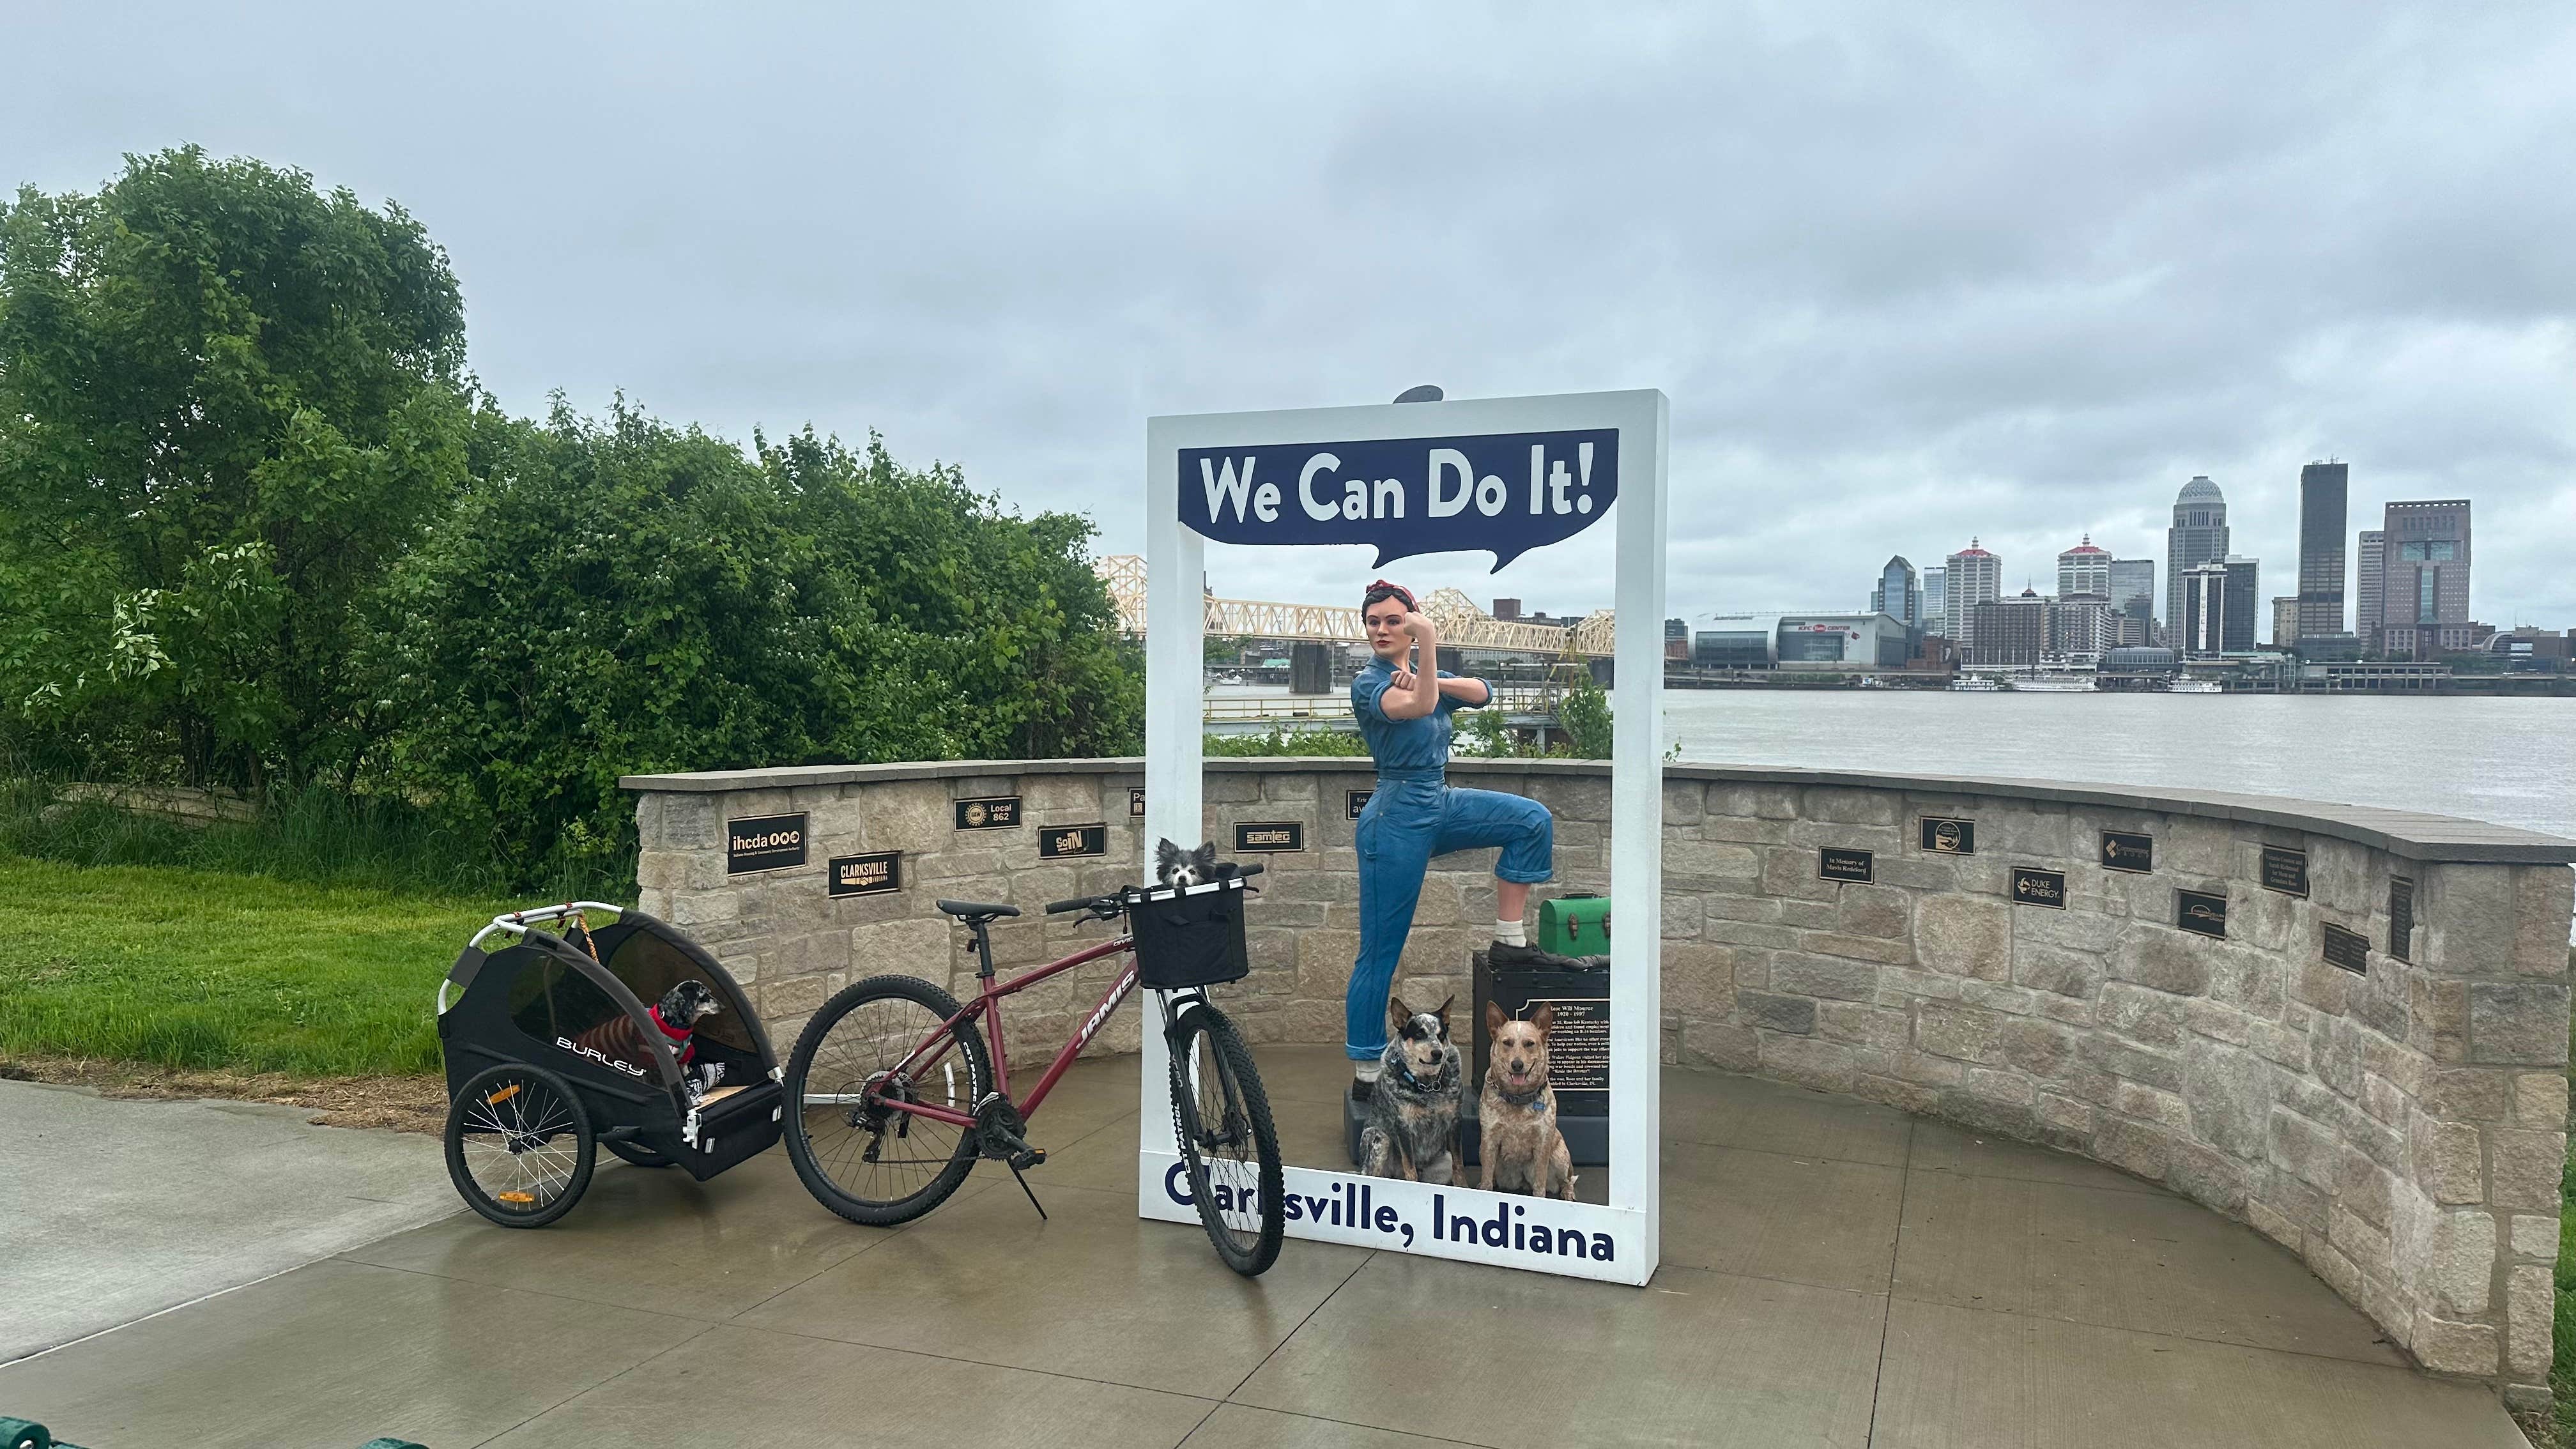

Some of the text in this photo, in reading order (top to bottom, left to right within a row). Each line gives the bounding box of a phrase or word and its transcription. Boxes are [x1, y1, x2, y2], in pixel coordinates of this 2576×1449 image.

[1200, 442, 1594, 524] We Can Do It!
[990, 804, 1012, 812] Local
[993, 813, 1009, 821] 862
[733, 833, 768, 850] ihcda
[840, 861, 887, 878] CLARKSVILLE
[1836, 858, 1857, 866] Memory
[2032, 879, 2050, 889] DUKE
[2031, 888, 2059, 898] ENERGY
[1076, 970, 1135, 1049] JAMIS
[556, 1036, 641, 1076] BURLEY
[963, 1041, 973, 1062] CST
[1174, 1103, 1186, 1149] PATROL
[1165, 1162, 1615, 1262] Carsville, Indiana
